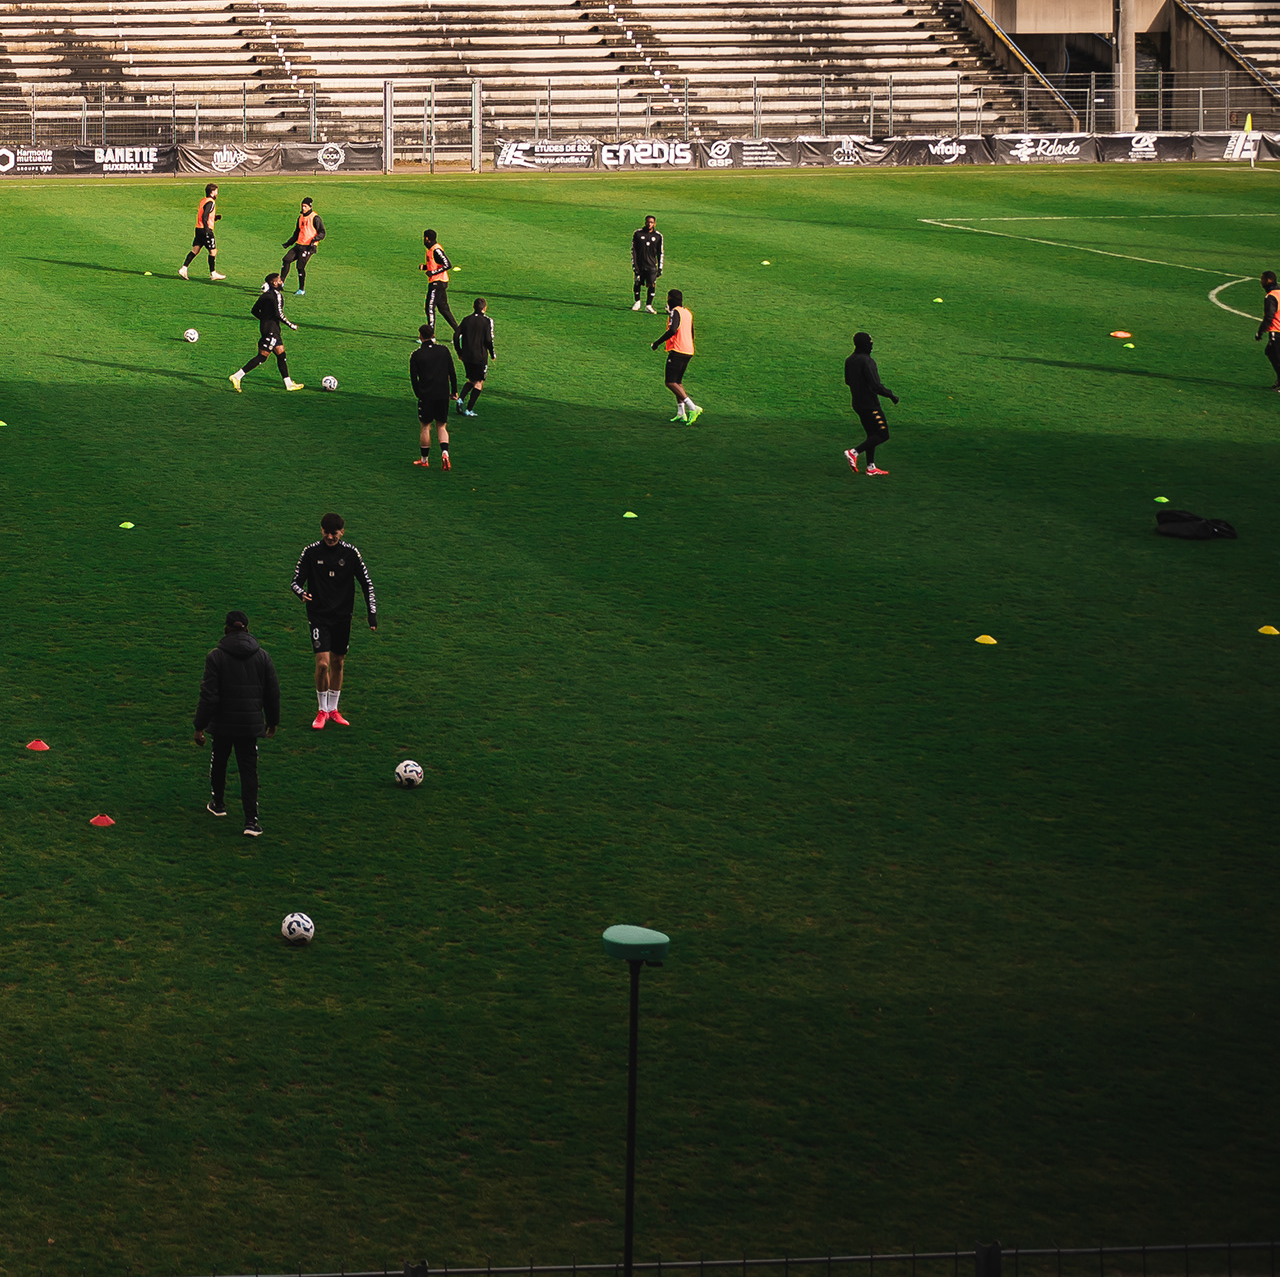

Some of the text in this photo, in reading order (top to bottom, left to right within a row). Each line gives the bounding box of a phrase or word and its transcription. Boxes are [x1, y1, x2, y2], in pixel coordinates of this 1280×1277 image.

[565, 144, 577, 152] DE
[577, 144, 592, 152] SOL
[94, 147, 158, 163] BANETTE
[534, 156, 588, 164] www.etudis.fr
[707, 158, 734, 167] GSP
[103, 163, 154, 171] BUXEROLLES
[313, 627, 319, 640] 8
